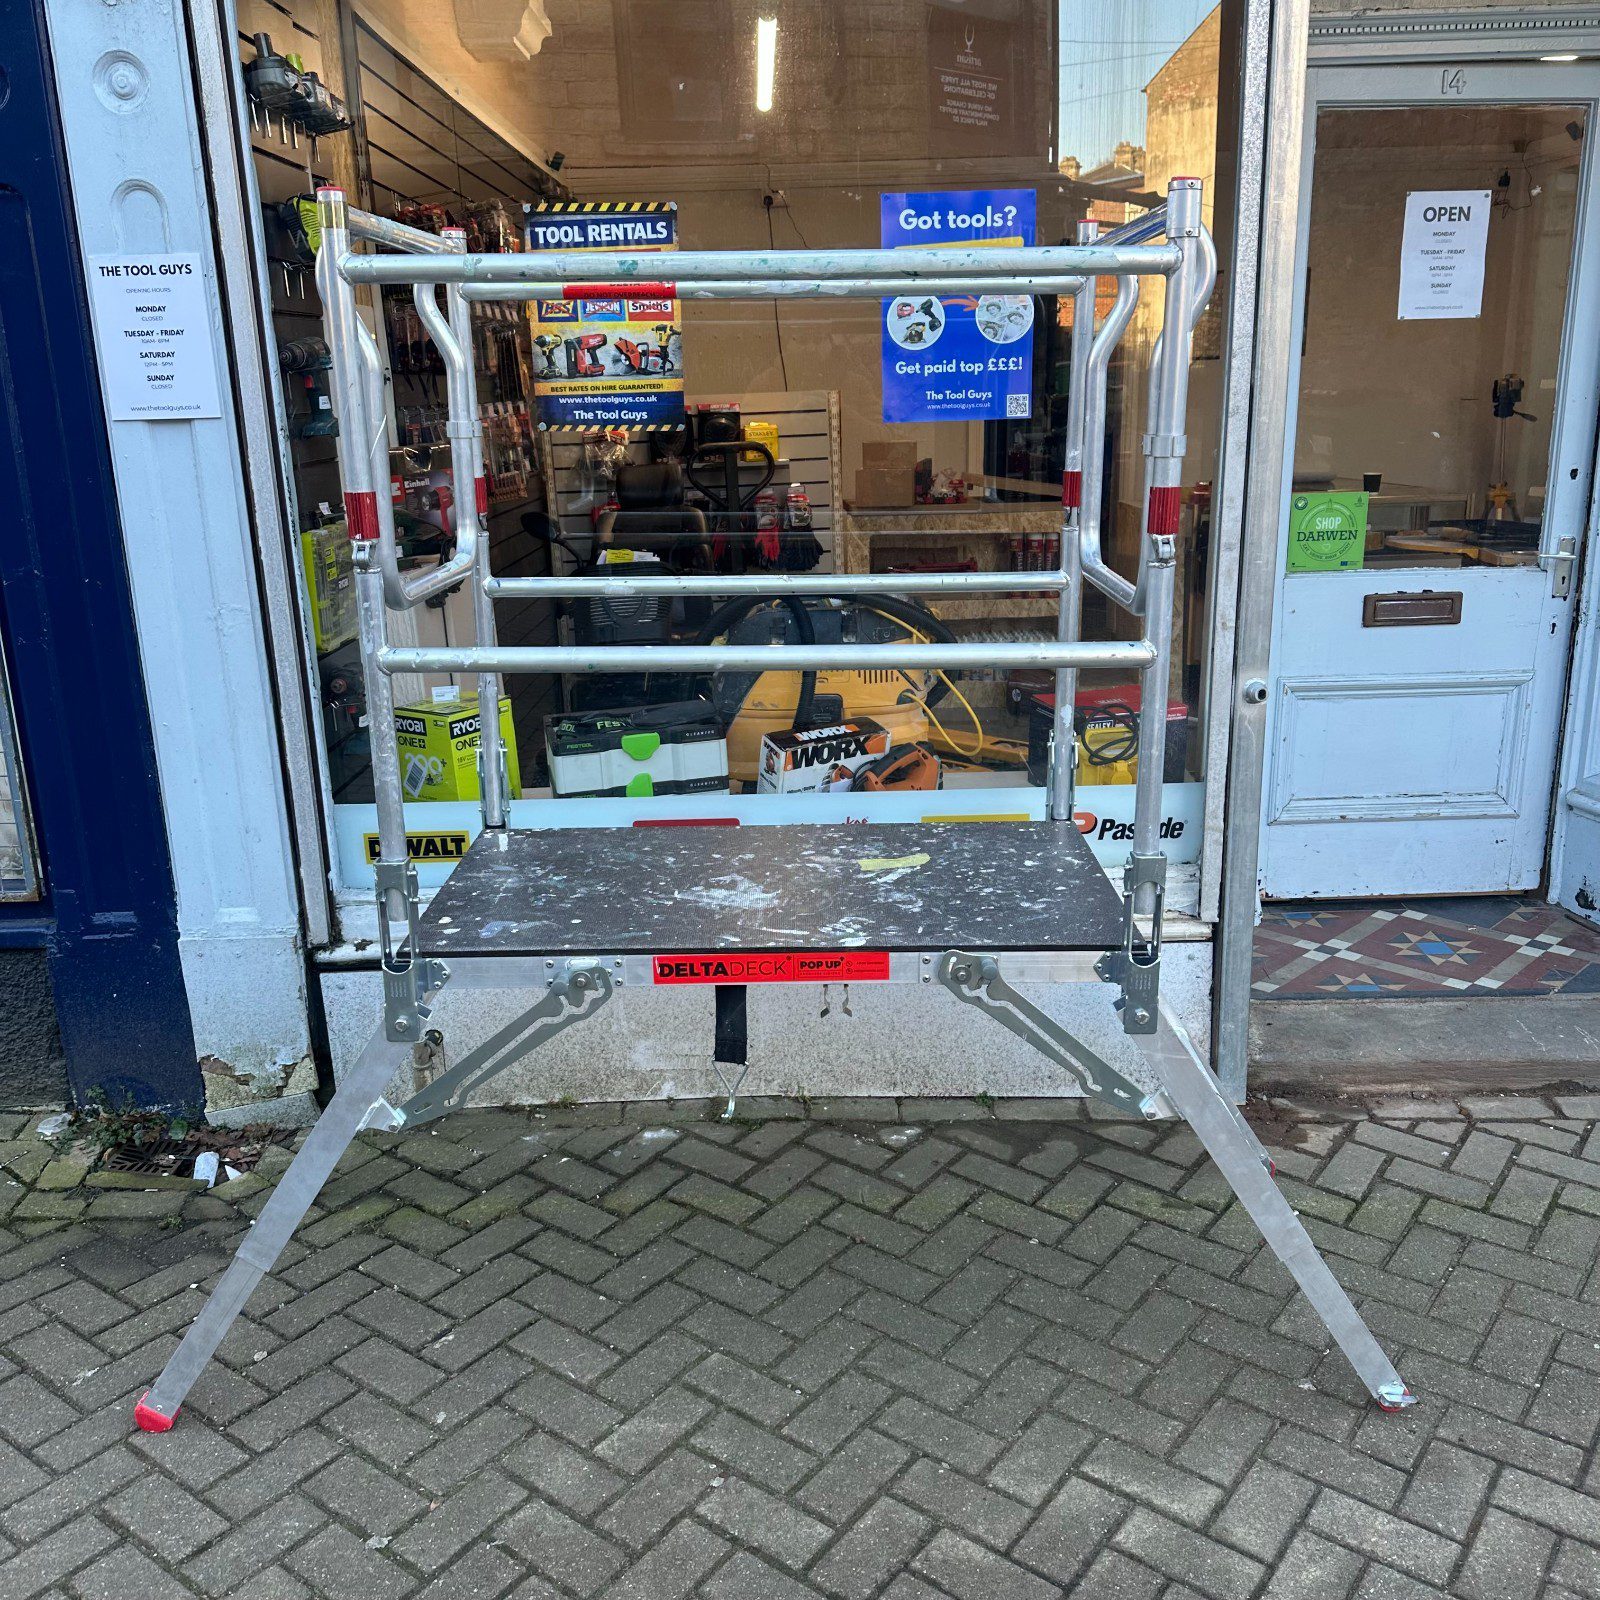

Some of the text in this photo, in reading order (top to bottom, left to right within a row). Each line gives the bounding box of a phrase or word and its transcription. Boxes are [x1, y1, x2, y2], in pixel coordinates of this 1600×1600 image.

[1442, 69, 1467, 94] 14
[899, 205, 1017, 230] Got tools?
[1423, 206, 1471, 222] OPEN
[535, 221, 668, 244] TOOL RENTALS
[99, 264, 192, 277] THE TOOL GUYS
[632, 302, 669, 311] Smiths
[124, 330, 154, 338] TUESDAY
[895, 357, 1023, 376] Get paid top £££!
[618, 383, 664, 391] GUARANTEED!
[558, 395, 657, 404] www.thetoolguys.co.uk
[925, 389, 992, 401] The Tool Guys
[927, 402, 991, 410] www.thetoolguys.co.uk
[573, 410, 648, 421] The Tool Guys
[404, 477, 430, 488] Einhell
[1316, 516, 1342, 530] SHOP
[1297, 530, 1358, 542] DARWEN
[395, 718, 426, 733] RYOBI
[451, 716, 481, 736] RYOB
[797, 725, 853, 741] WORX
[791, 734, 871, 769] WORX
[1098, 817, 1184, 840] Pasde
[369, 837, 466, 857] DWALT
[800, 961, 842, 970] POP UP
